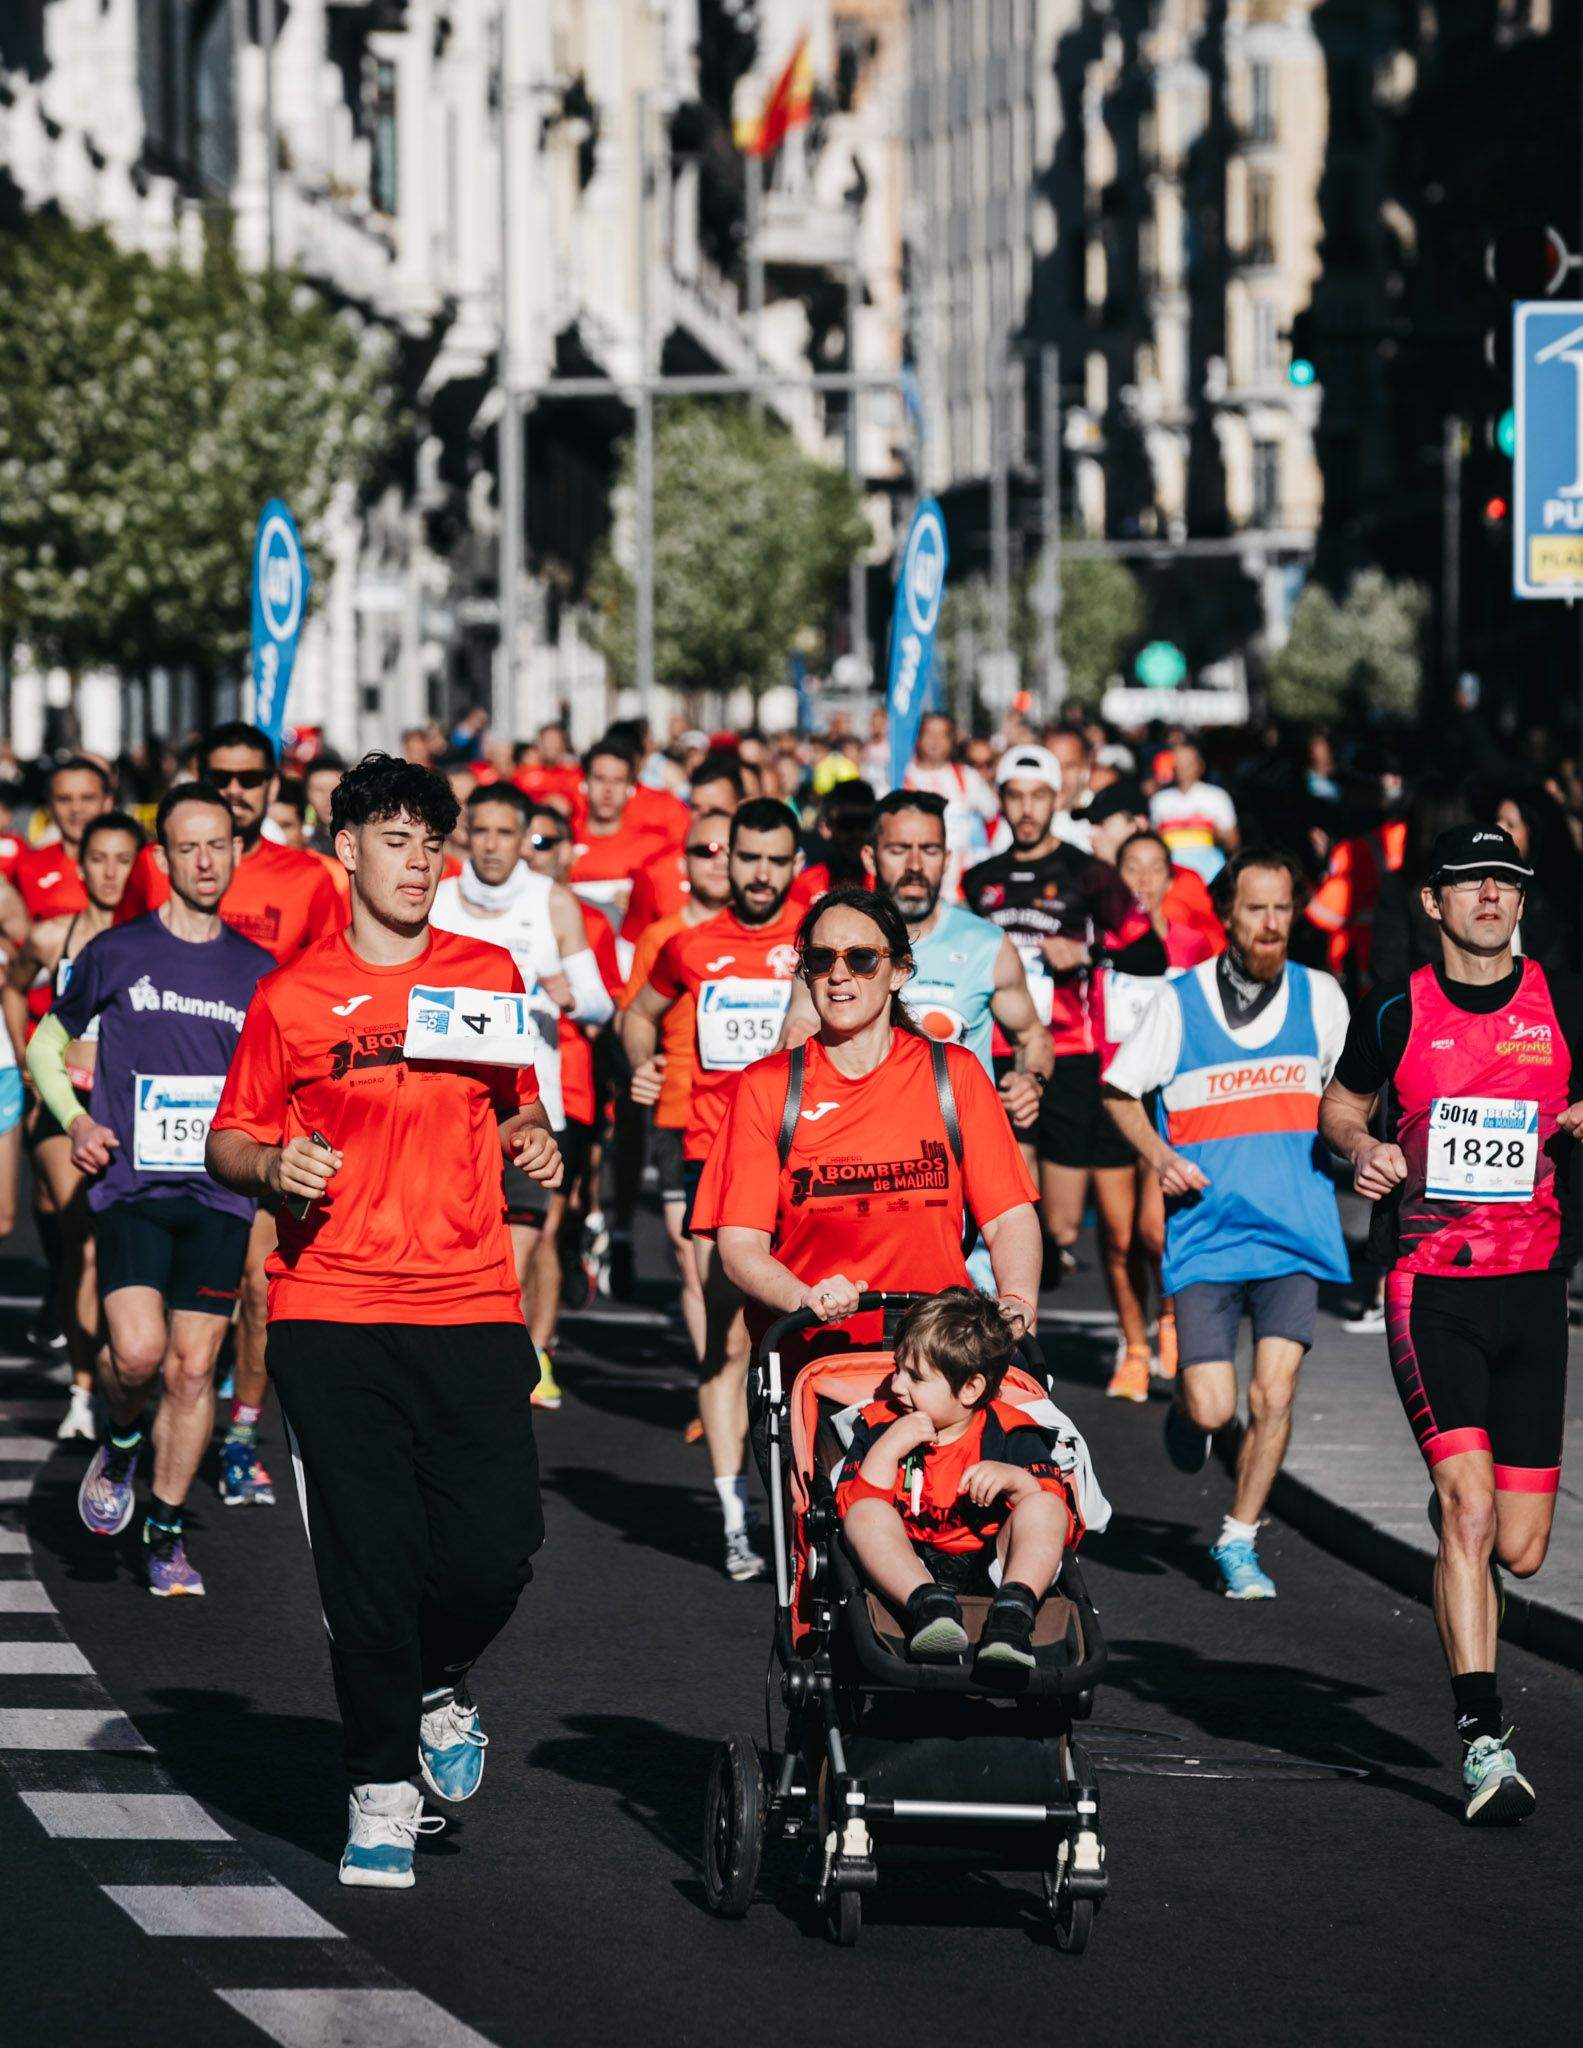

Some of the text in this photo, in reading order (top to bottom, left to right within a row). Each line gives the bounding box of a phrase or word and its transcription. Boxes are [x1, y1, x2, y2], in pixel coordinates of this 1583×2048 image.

[462, 1013, 492, 1035] 4
[726, 1018, 774, 1041] 935
[1207, 1063, 1306, 1094] TOPACIO
[1440, 1103, 1478, 1127] 5014
[1443, 1137, 1525, 1168] 1828
[826, 1158, 945, 1180] BOMBEROS
[873, 1170, 946, 1192] de MADRID
